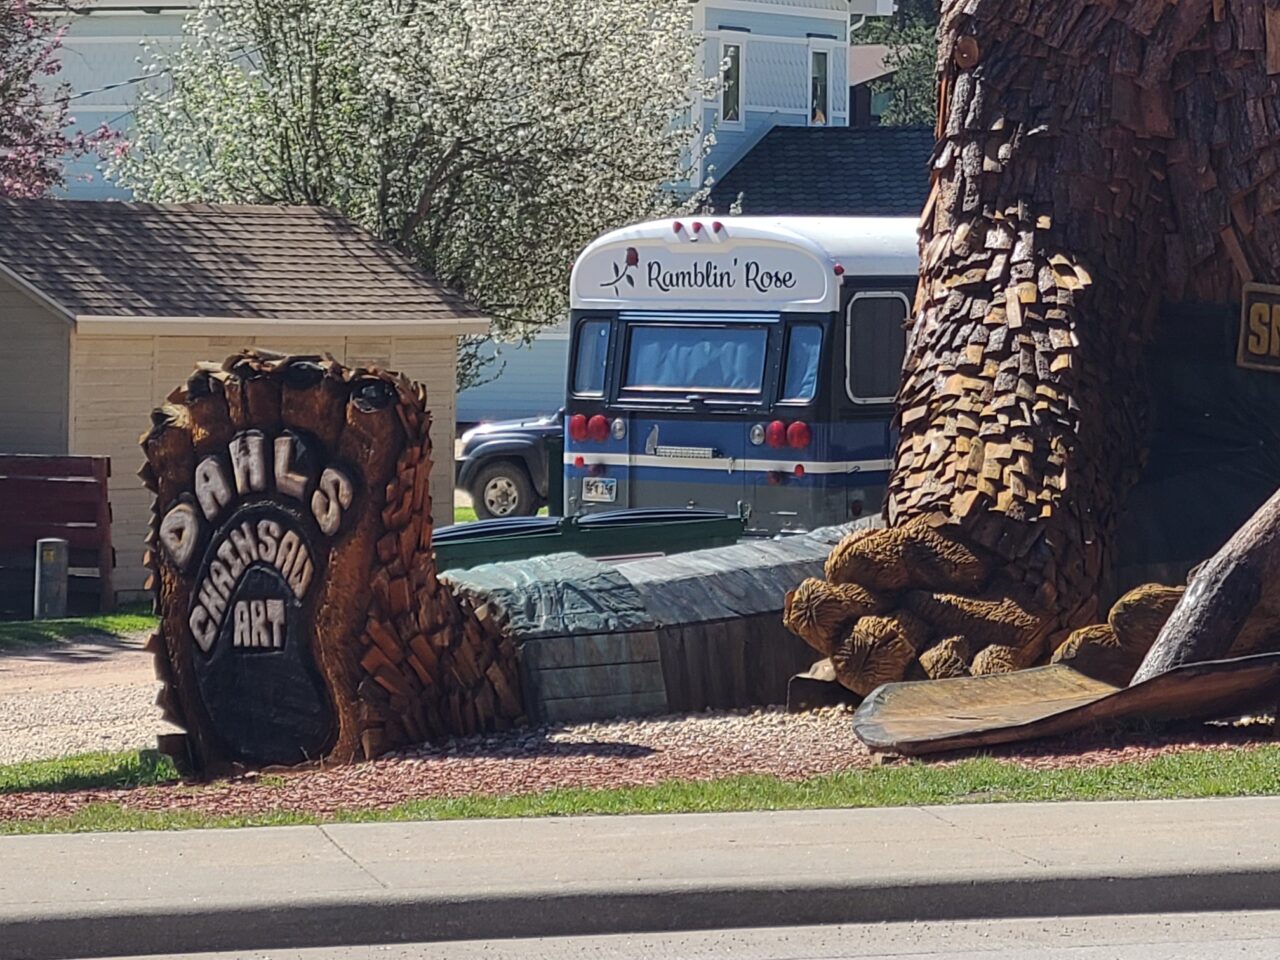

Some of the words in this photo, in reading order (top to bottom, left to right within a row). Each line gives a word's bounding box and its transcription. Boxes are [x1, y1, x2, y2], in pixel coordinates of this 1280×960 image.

[647, 258, 738, 292] Ramblin'
[744, 261, 797, 293] Rose
[189, 519, 315, 653] CHAINSAW
[233, 599, 286, 649] ART
